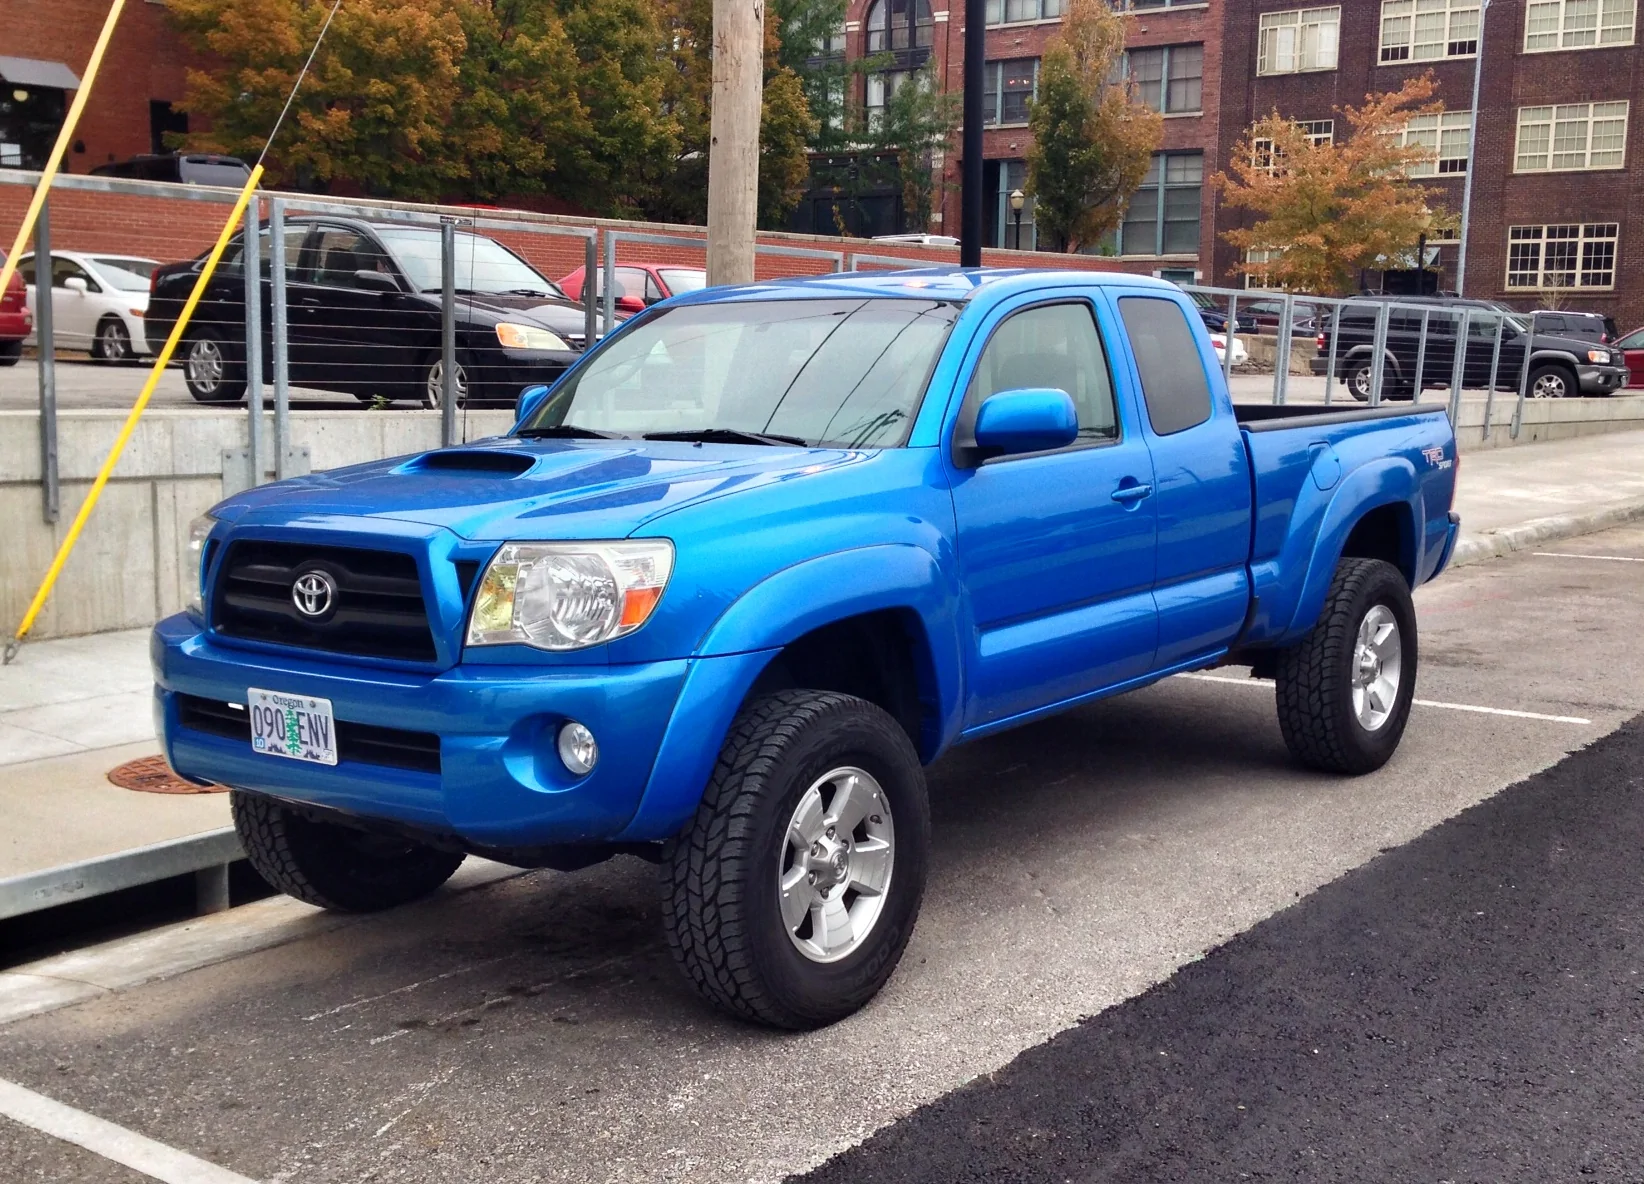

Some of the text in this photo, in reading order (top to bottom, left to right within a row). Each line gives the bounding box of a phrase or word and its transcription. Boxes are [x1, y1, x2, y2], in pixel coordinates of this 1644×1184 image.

[272, 694, 304, 709] Oregon
[253, 704, 329, 749] 090 ENV
